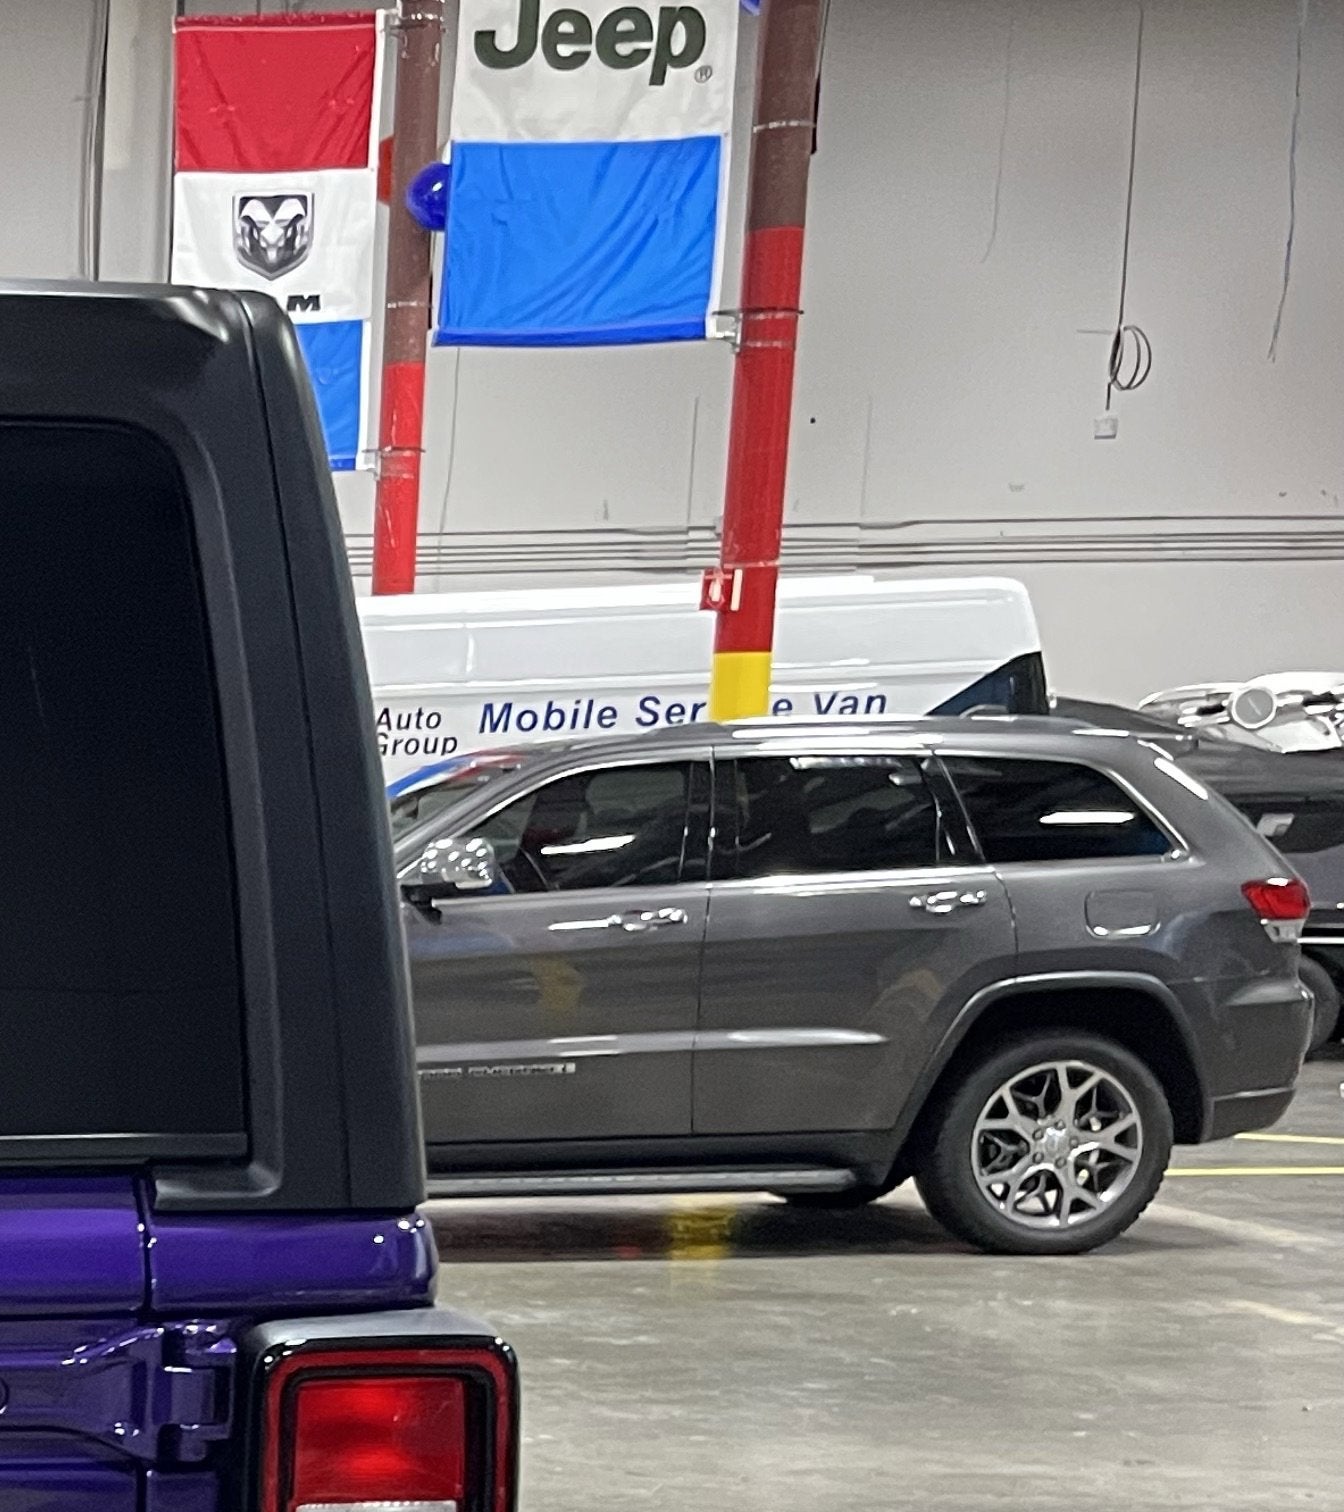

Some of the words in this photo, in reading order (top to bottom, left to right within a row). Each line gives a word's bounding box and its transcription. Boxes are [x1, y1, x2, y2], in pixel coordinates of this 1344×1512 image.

[474, 0, 706, 86] Jeep
[376, 707, 442, 731] Auto
[479, 699, 618, 734] Mobile
[635, 695, 793, 727] Sere
[814, 692, 887, 716] Van
